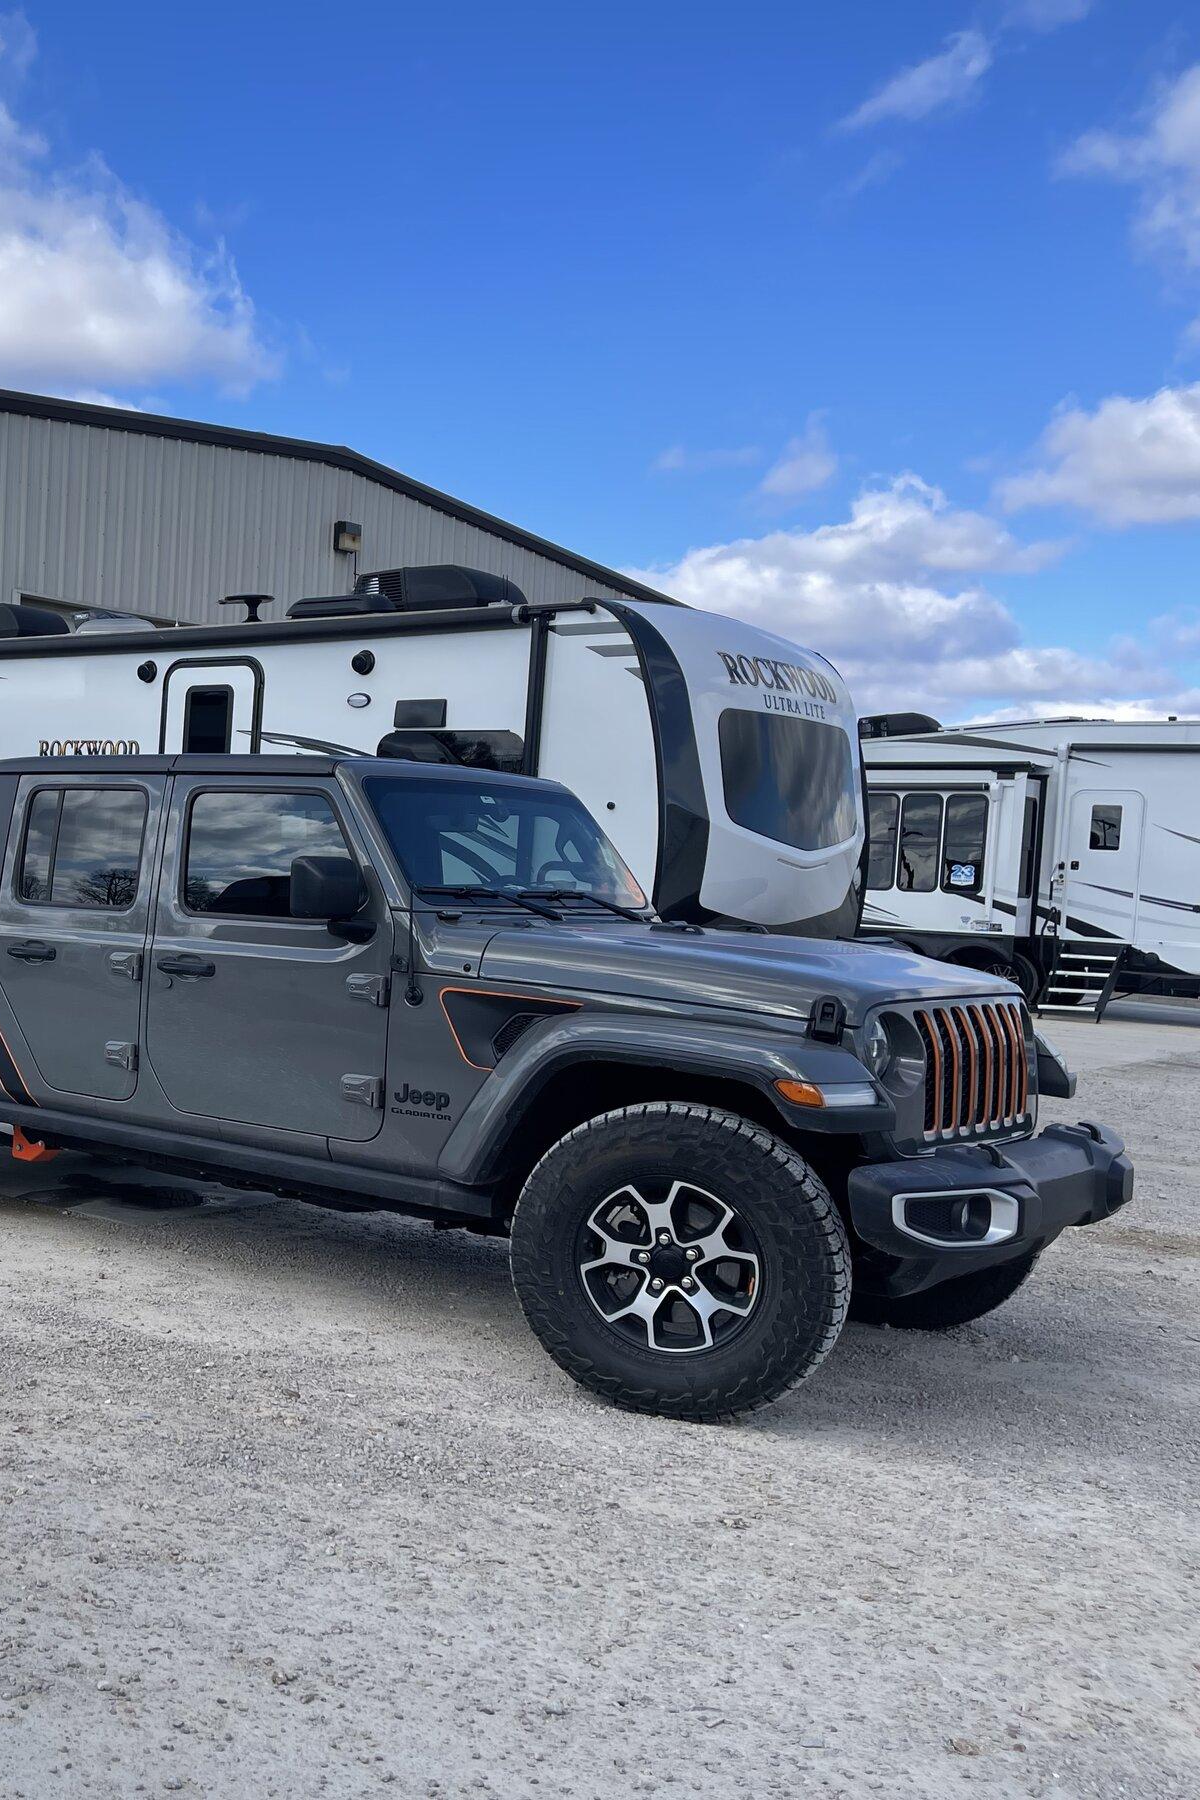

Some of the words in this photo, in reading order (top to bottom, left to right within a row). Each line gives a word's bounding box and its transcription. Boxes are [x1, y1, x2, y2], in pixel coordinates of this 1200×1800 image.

[716, 650, 838, 704] ROCKWOOD
[763, 694, 802, 714] ULTRA
[805, 701, 826, 720] LITE
[38, 739, 140, 756] ROCKWOOD
[394, 1083, 450, 1111] Jeep
[391, 1107, 452, 1121] GLADIATOR
